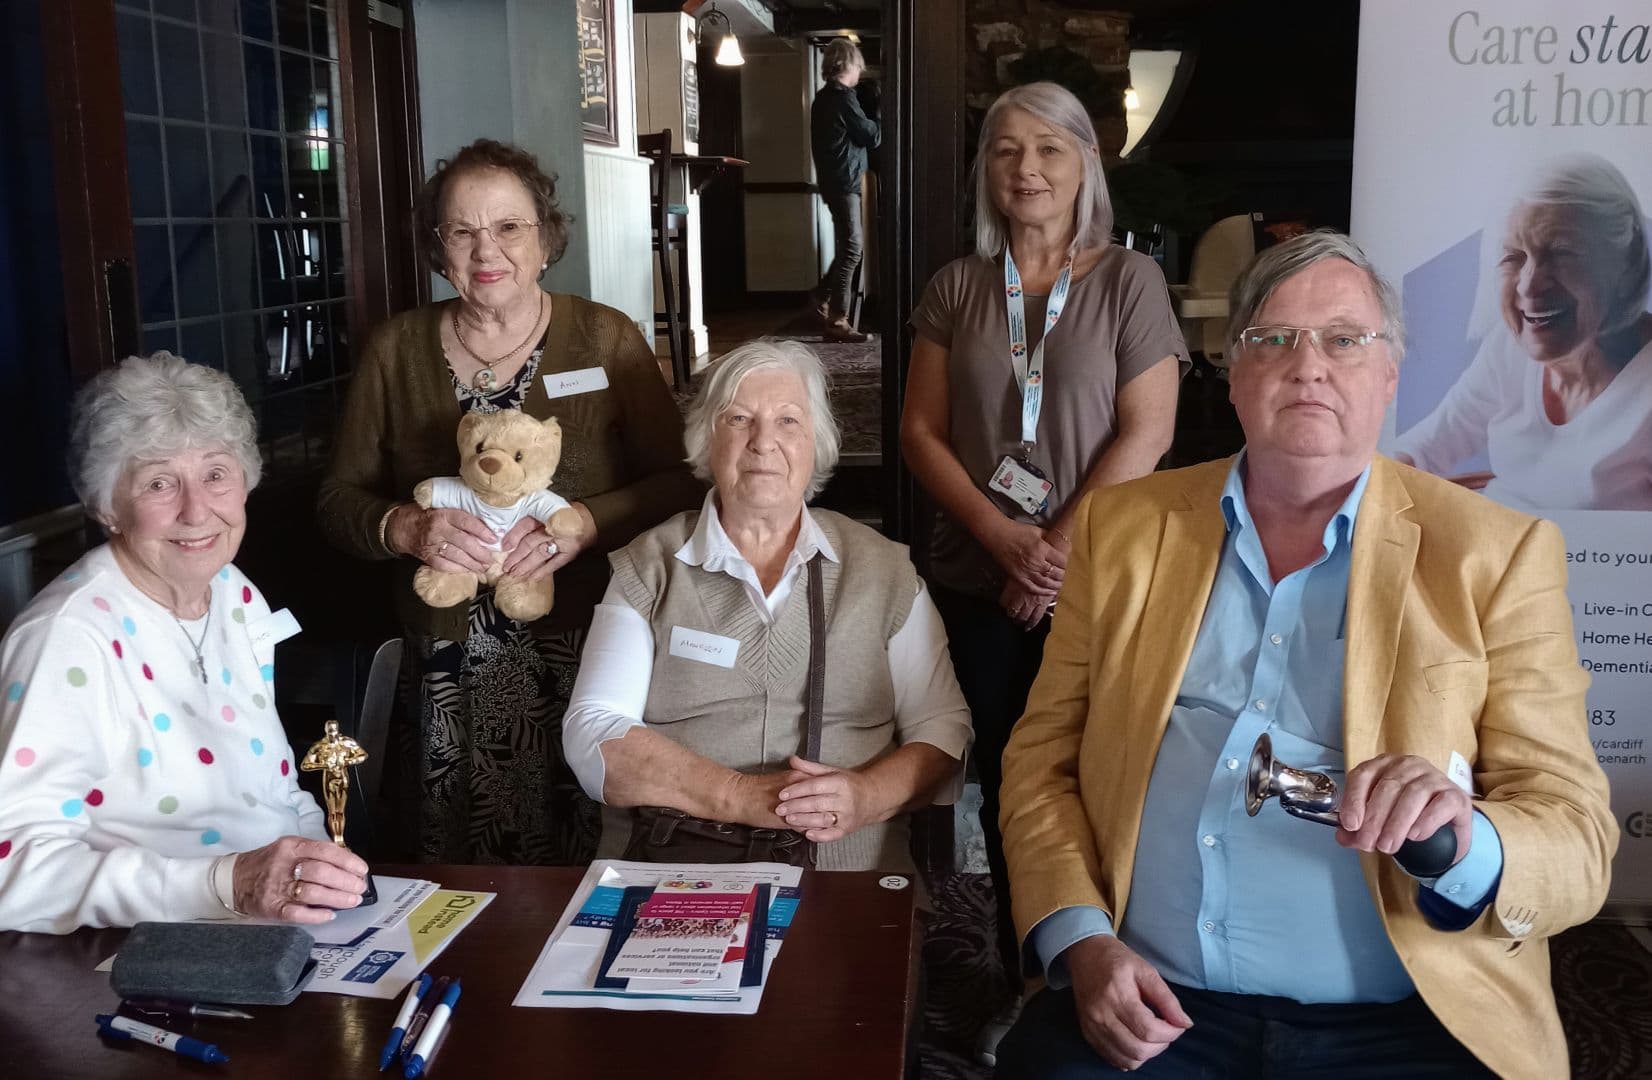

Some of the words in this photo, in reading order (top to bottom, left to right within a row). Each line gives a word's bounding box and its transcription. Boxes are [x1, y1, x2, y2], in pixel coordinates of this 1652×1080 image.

[1448, 10, 1559, 65] Care
[1492, 79, 1538, 127] at
[1592, 551, 1610, 563] to
[1584, 602, 1638, 616] Live-in
[1582, 631, 1631, 645] Home
[436, 909, 464, 928] home
